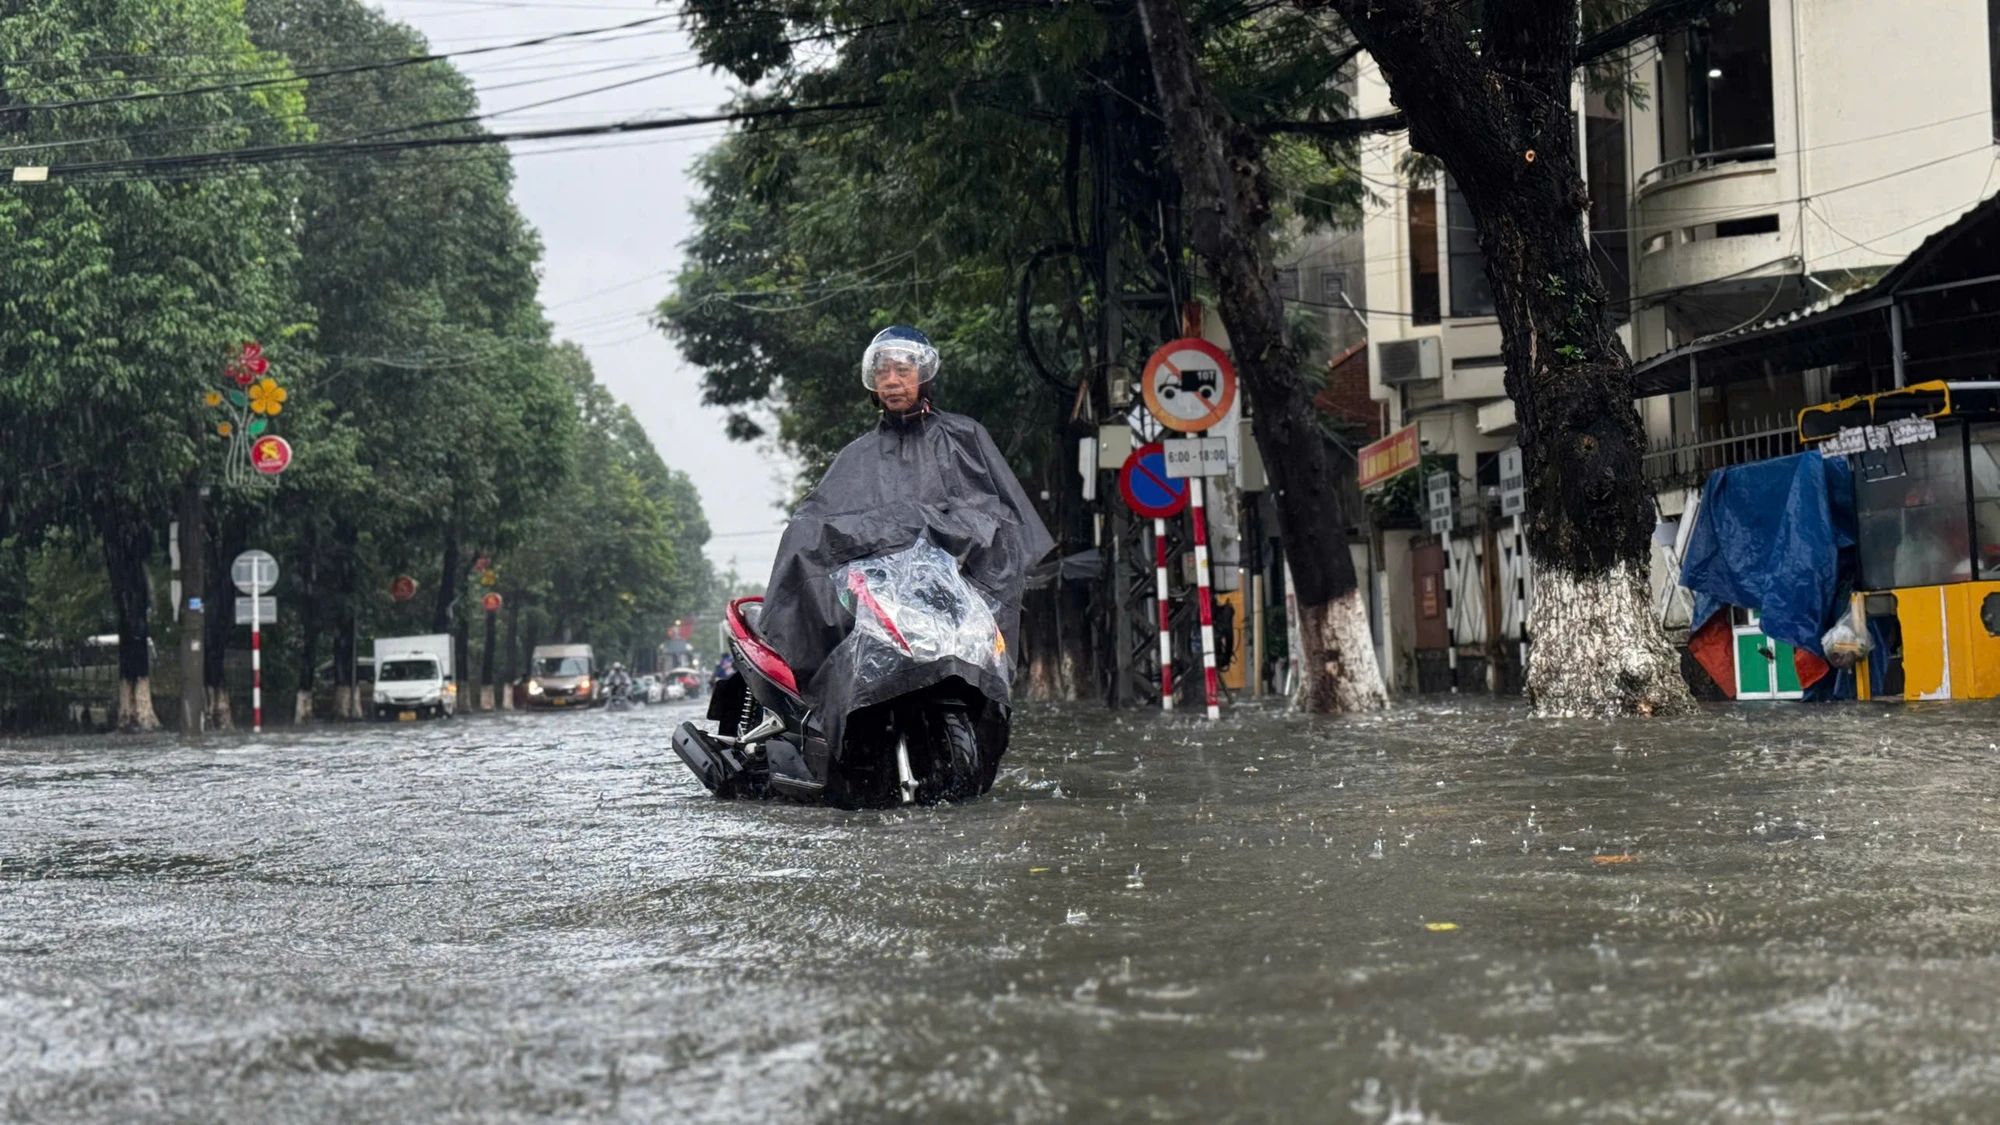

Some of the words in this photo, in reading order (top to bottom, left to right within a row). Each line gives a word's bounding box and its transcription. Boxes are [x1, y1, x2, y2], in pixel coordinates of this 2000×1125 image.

[1196, 371, 1215, 380] 10T
[1168, 450, 1190, 463] 6:00
[1198, 449, 1225, 461] 18:00
